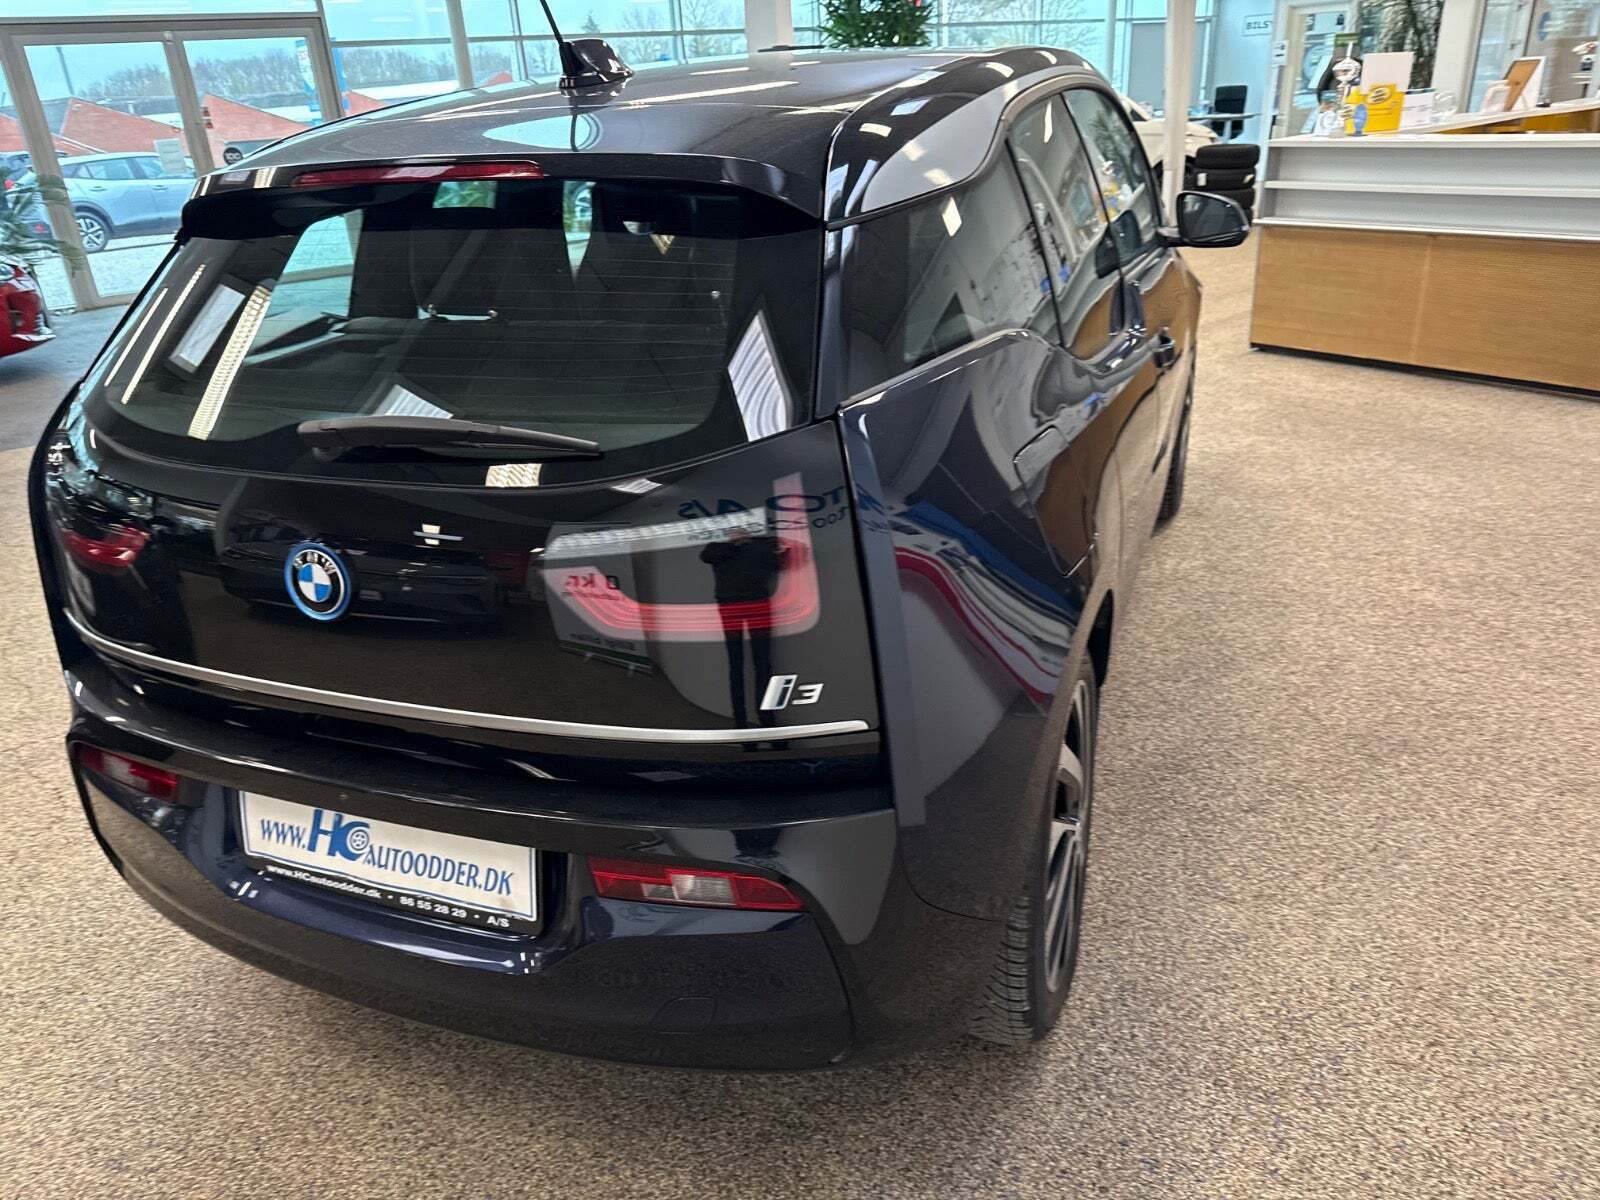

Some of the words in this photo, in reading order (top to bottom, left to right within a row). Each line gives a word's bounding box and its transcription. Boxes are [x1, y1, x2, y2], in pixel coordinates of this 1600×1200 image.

[760, 675, 824, 710] i3
[417, 900, 432, 910] 55
[433, 904, 450, 914] 28
[451, 908, 467, 918] 29
[487, 916, 510, 927] A/S
